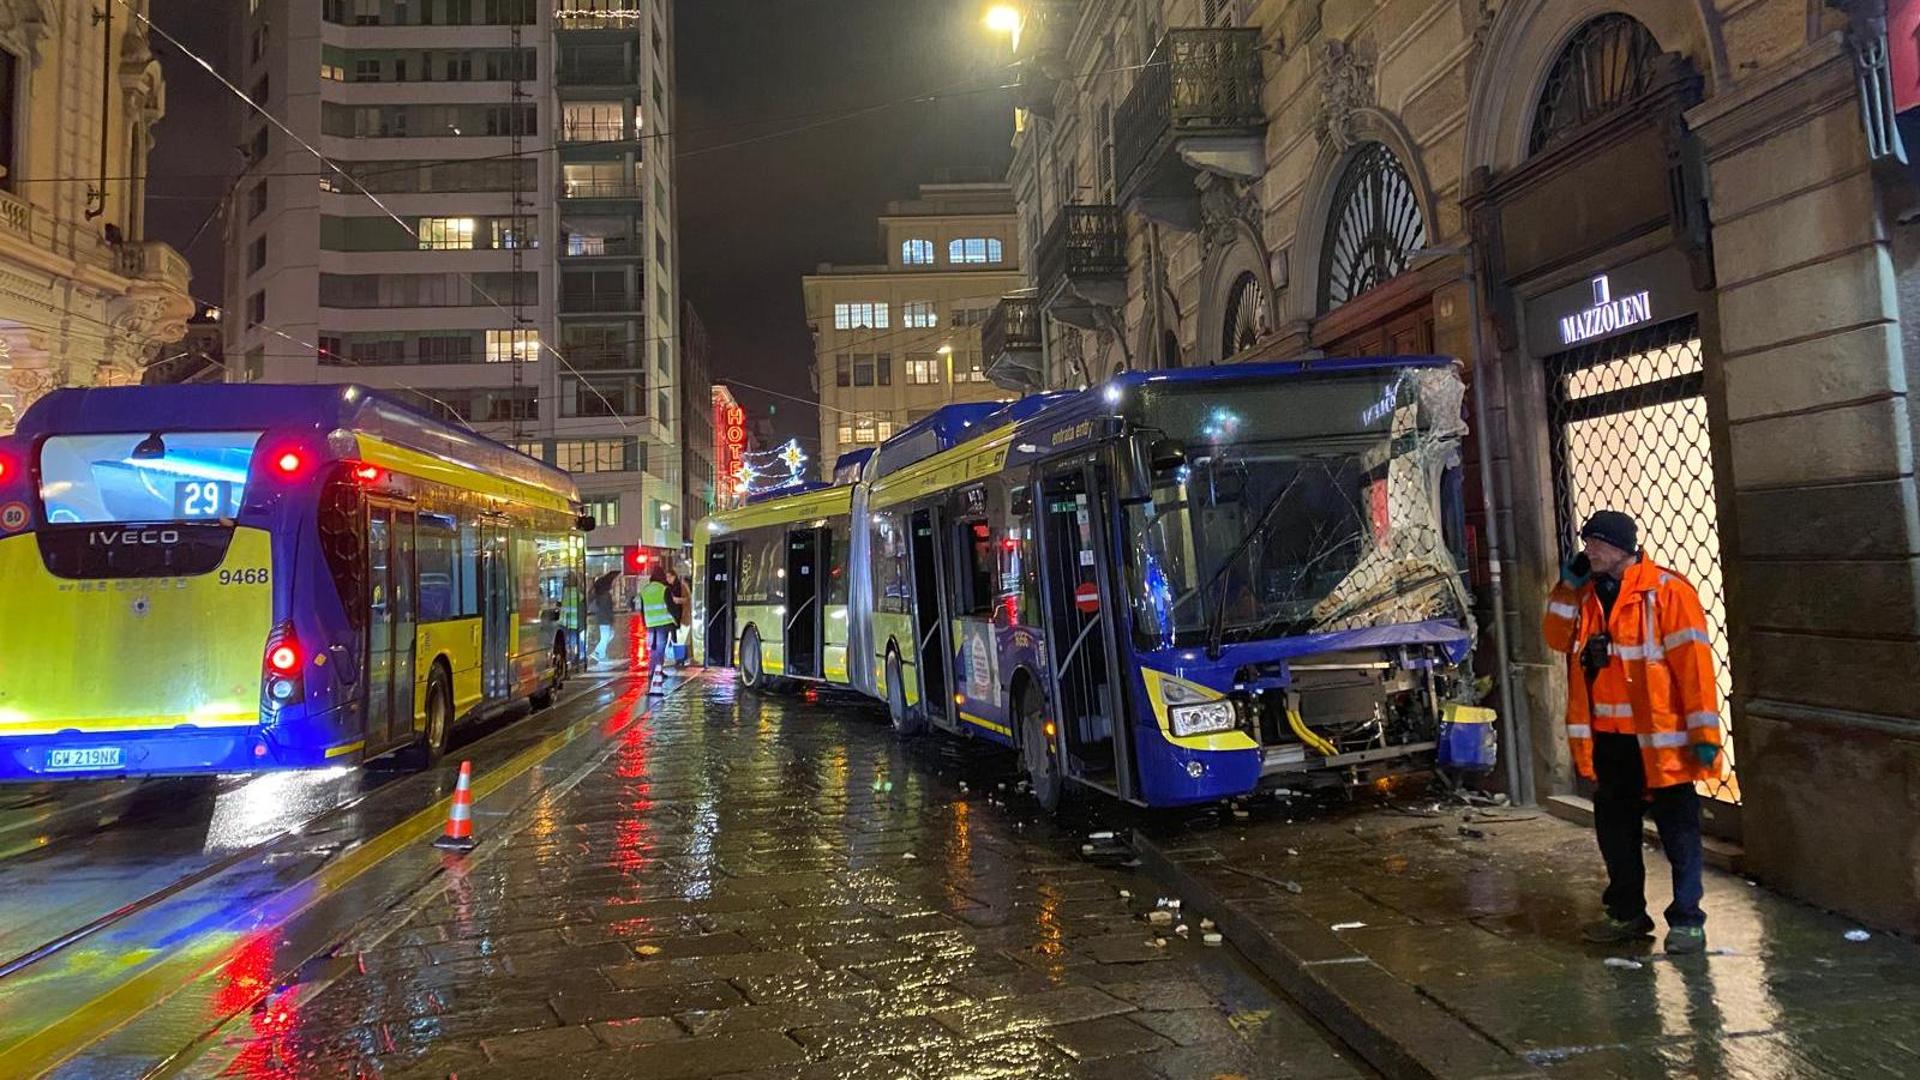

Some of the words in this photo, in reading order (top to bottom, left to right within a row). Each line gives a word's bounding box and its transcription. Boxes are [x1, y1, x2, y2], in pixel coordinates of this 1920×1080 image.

[1561, 291, 1652, 344] MAZZOLENI
[727, 407, 744, 497] HOTEL
[184, 481, 219, 515] 29
[6, 510, 22, 523] 80
[89, 529, 180, 545] IVECO
[218, 567, 270, 586] 9468
[75, 749, 118, 765] 219NK
